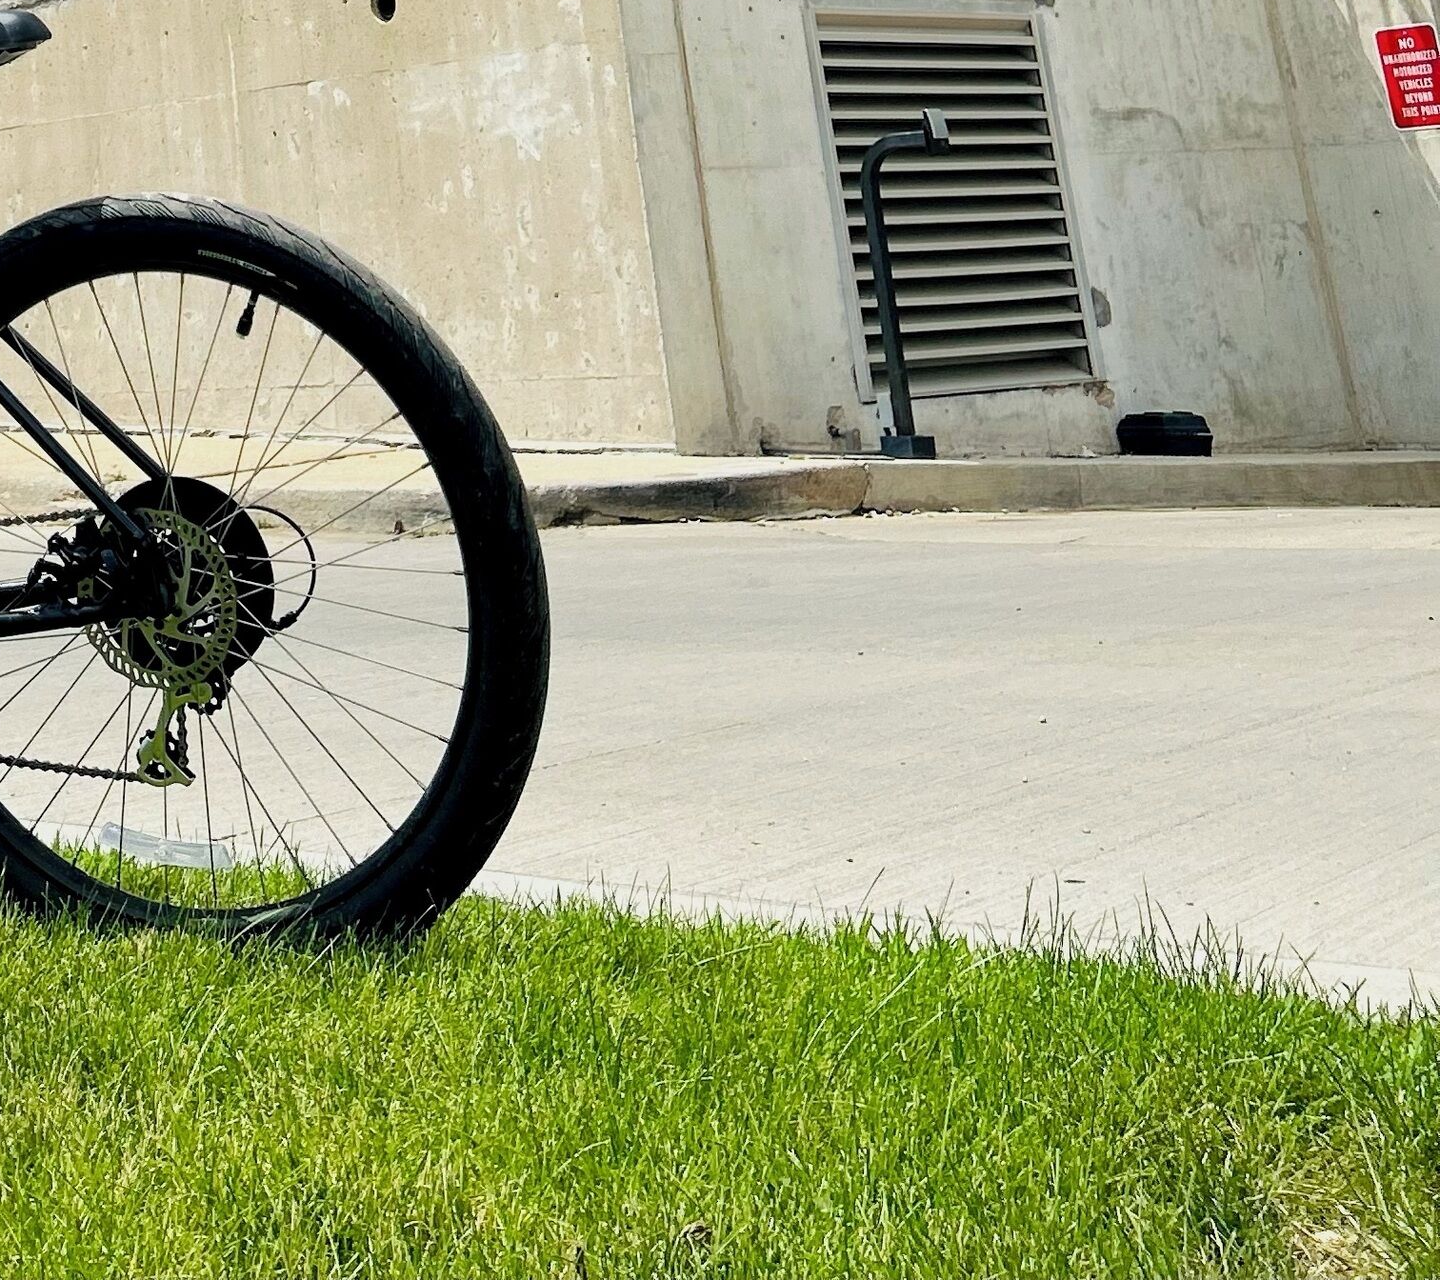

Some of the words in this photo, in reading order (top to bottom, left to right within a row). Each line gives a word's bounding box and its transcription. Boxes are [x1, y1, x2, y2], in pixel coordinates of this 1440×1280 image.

[1398, 37, 1415, 50] NO
[1382, 49, 1437, 65] UNAUTHORIZED
[1392, 63, 1433, 78] MOTORIZED
[1399, 77, 1434, 91] VEHICLES
[1404, 91, 1434, 104] BEYOND
[1401, 106, 1420, 118] THIS
